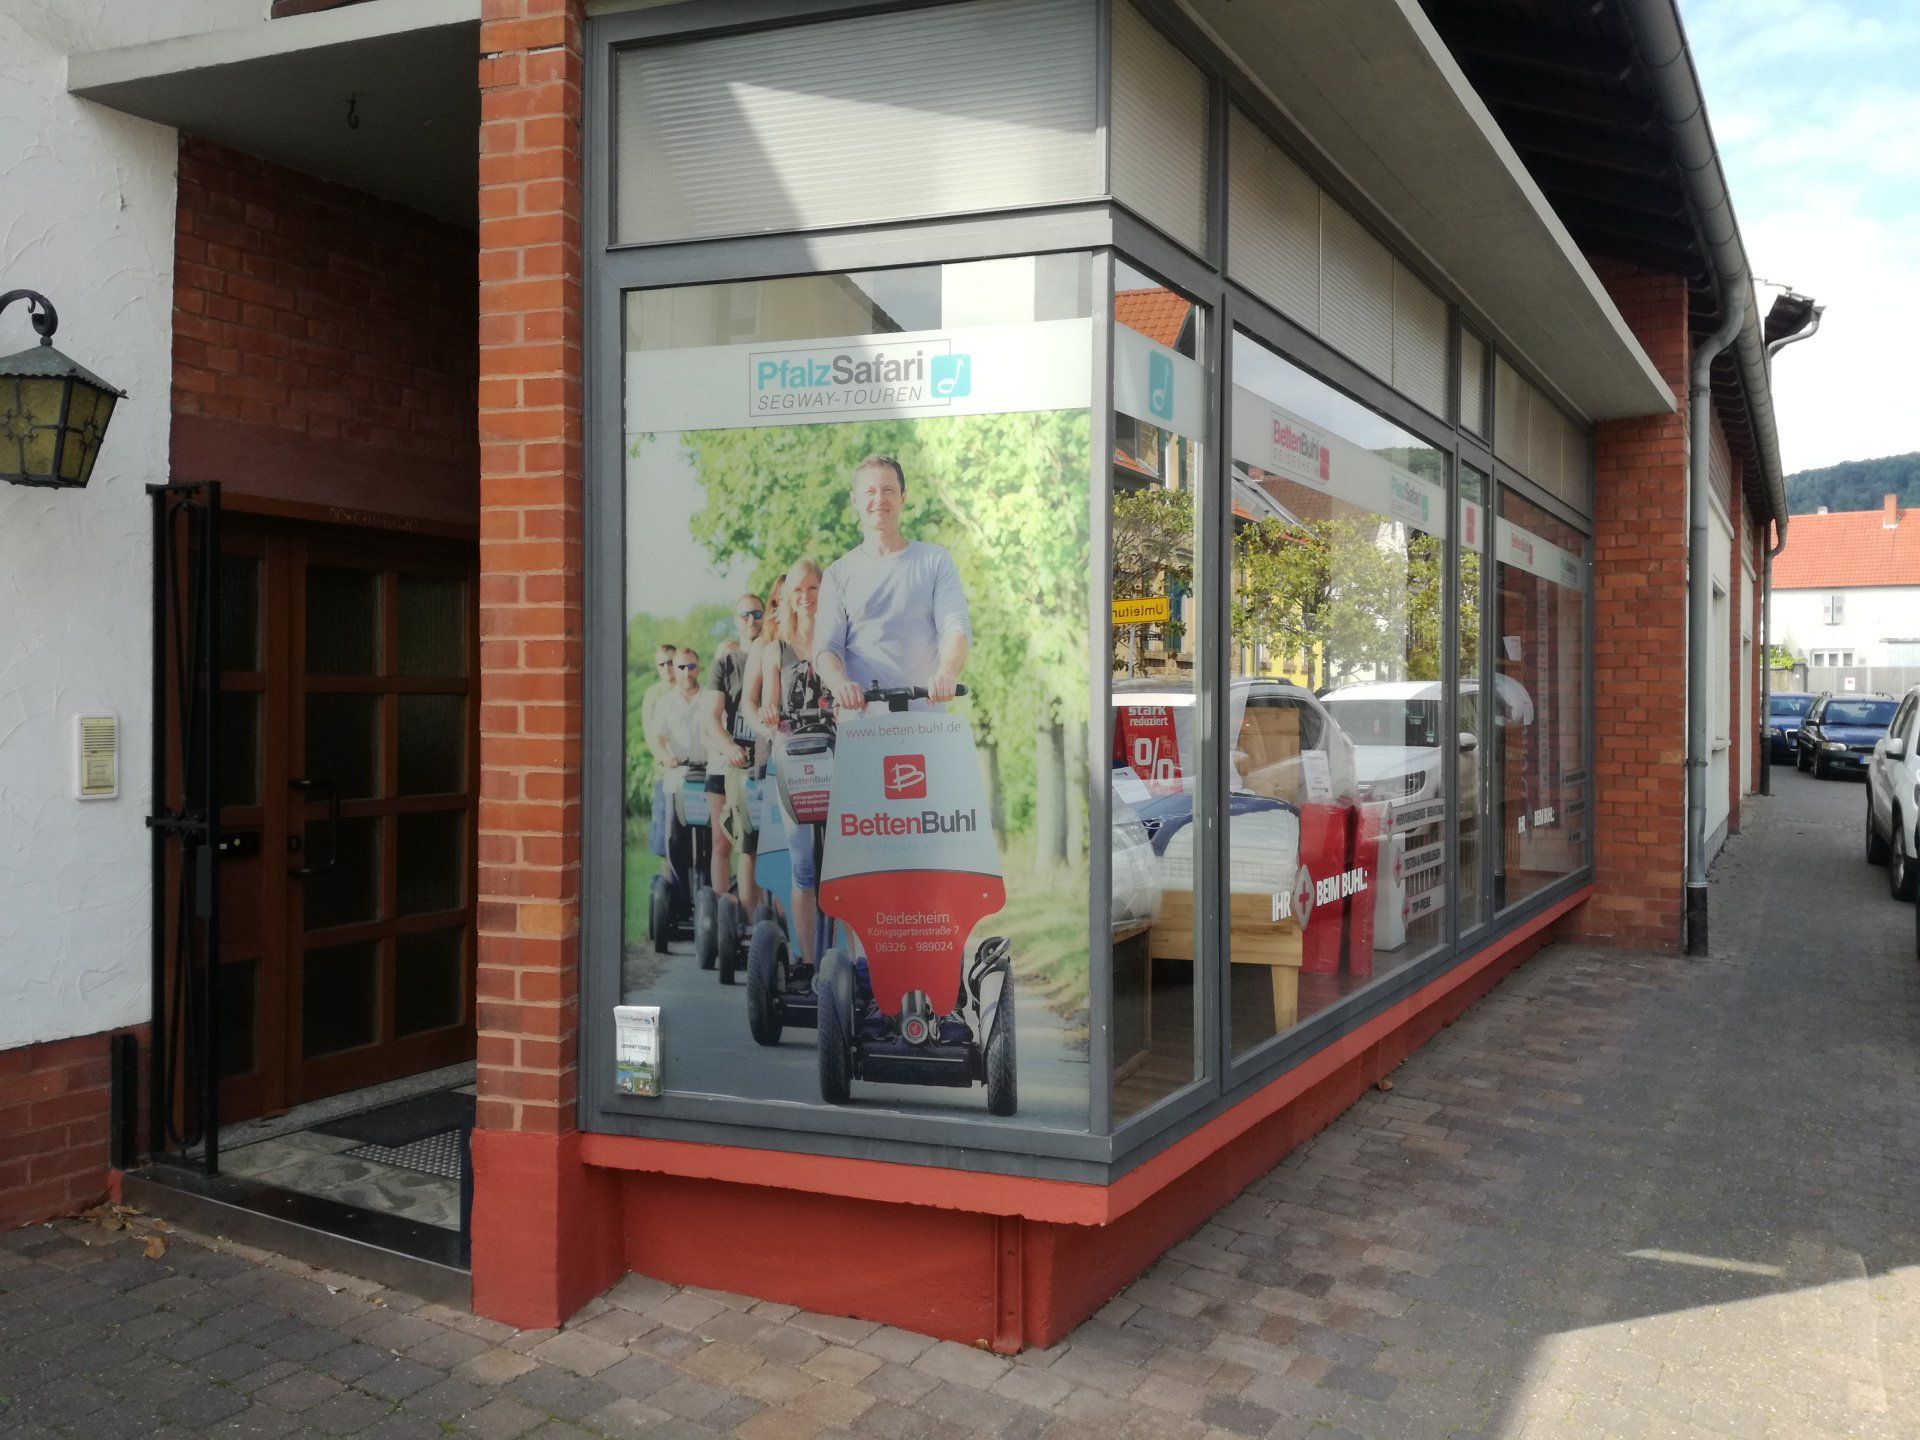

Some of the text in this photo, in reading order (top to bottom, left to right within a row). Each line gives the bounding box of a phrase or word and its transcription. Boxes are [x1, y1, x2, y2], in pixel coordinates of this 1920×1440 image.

[757, 350, 923, 390] PfalzSafari
[758, 386, 923, 410] SEGWAY-TOUREN
[1272, 418, 1319, 461] BettenBuhl
[846, 721, 961, 738] www.betten-buhl.de
[1130, 716, 1169, 727] reduziert
[840, 808, 976, 836] BettenBuhl
[1272, 867, 1368, 922] IHR BEIM BUHL:
[876, 911, 950, 924] Deidesheim
[867, 925, 959, 939] Königsgartenstraße 7
[875, 942, 906, 953] 06326
[915, 941, 953, 952] 989024
